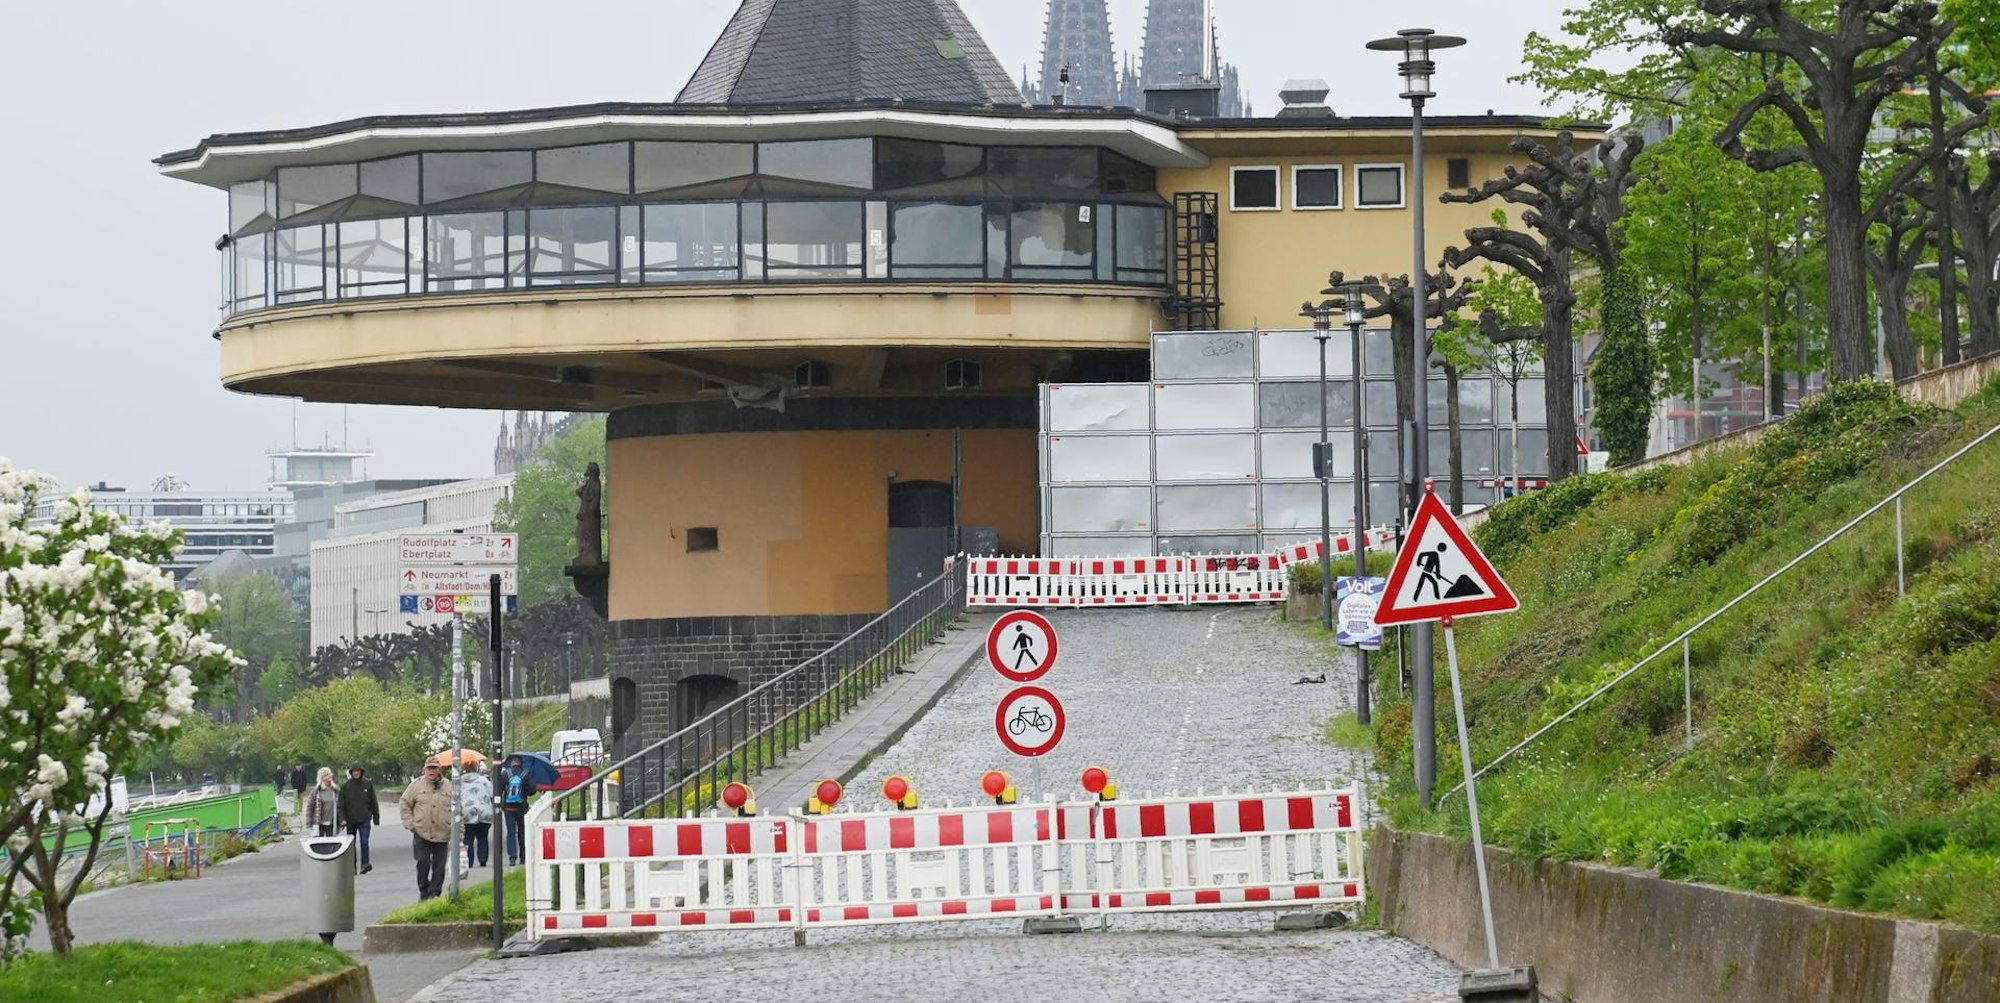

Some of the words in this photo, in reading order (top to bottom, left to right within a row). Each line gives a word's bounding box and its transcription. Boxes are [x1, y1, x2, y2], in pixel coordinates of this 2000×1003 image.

[1080, 208, 1088, 221] 4
[402, 537, 457, 548] Rudolfplatz
[402, 549, 452, 560] Ebertplatz
[421, 570, 469, 579] Neumarkt
[1346, 580, 1374, 593] Volt
